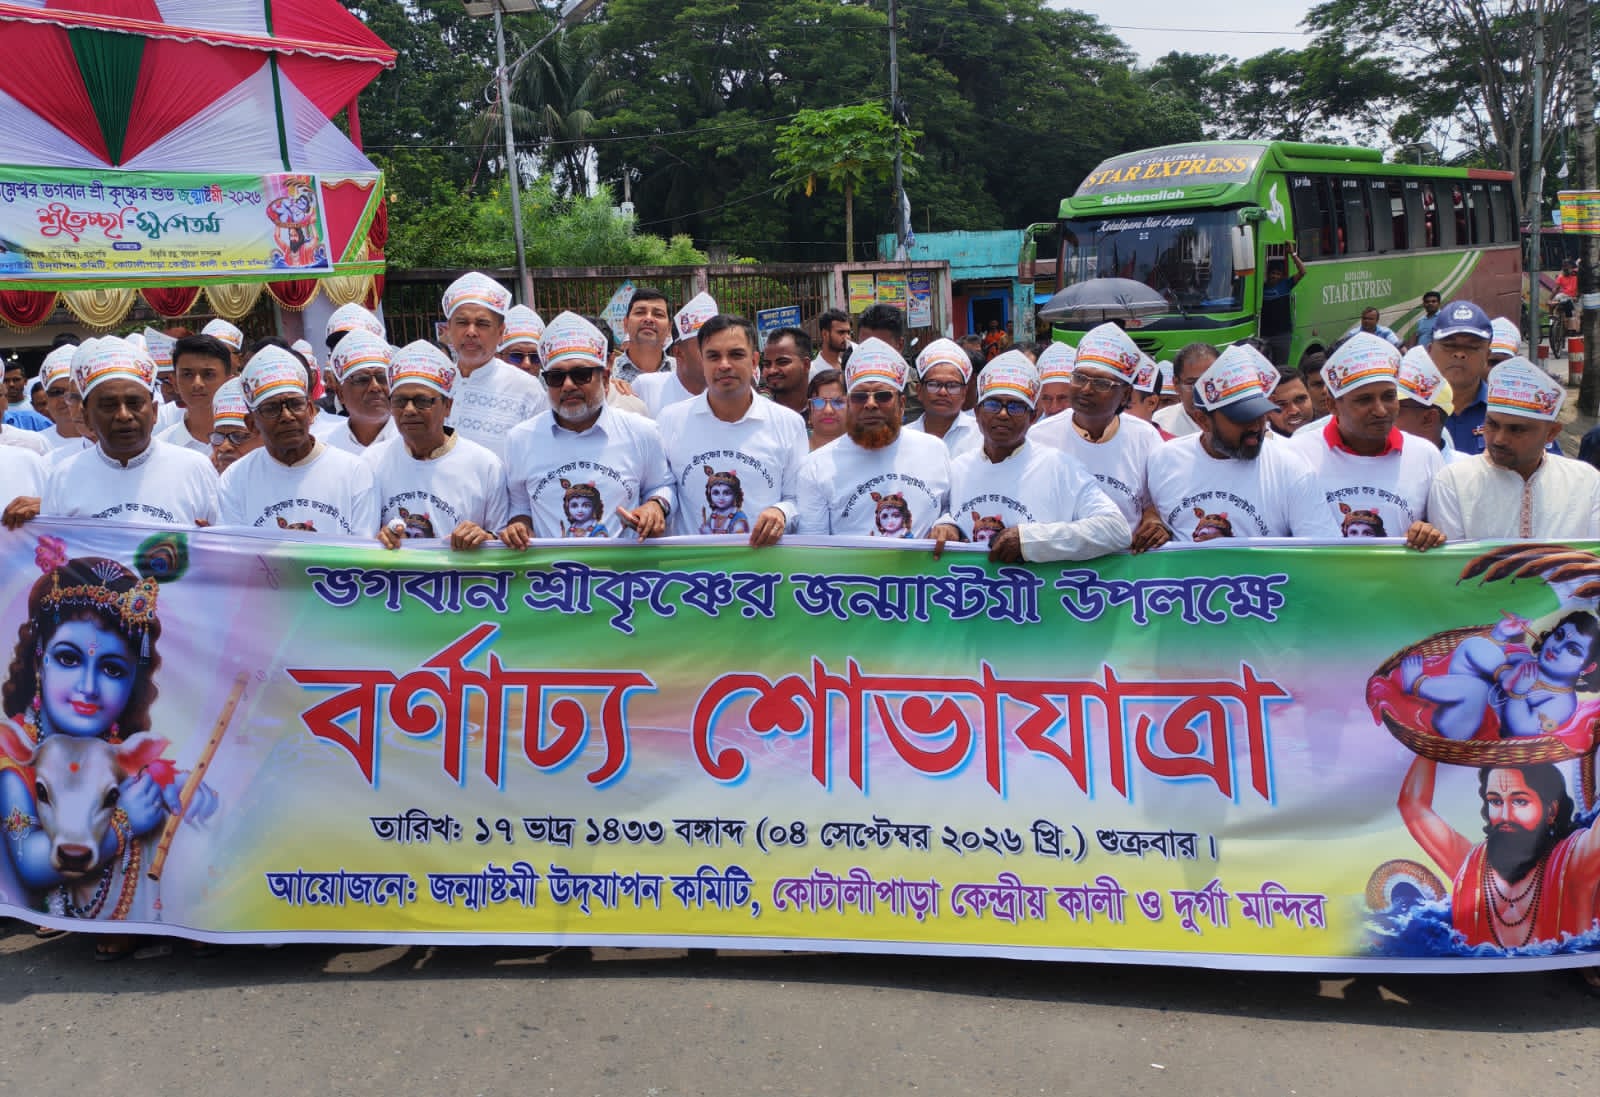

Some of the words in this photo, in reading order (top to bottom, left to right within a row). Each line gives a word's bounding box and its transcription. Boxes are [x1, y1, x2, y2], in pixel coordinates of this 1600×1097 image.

[1083, 165, 1142, 188] STAR
[1141, 157, 1251, 180] EXPRESS
[0, 182, 38, 203] মেশ্বর
[41, 182, 87, 201] ভগবান
[89, 180, 105, 201] শ্রী
[109, 186, 147, 208] কৃষ্ণের
[150, 187, 175, 202] শুভ
[1102, 189, 1185, 205] Subhanallah
[1322, 284, 1350, 305] STAR
[1351, 279, 1392, 302] EXPRESS
[307, 565, 515, 613] ভগবান
[523, 561, 783, 635] শ্রীকৃষ্ণের
[790, 564, 1044, 625] জন্মাষ্টমী
[1055, 568, 1288, 626] উপলক্ষে
[285, 621, 660, 792] বর্ণাঢ্য
[691, 655, 1293, 806] শোভাযাত্রা
[370, 808, 463, 844] তারিখ:
[475, 815, 514, 844] ১৭
[524, 815, 577, 848] ভাদ্র
[585, 817, 664, 845] ১৪৩৩
[672, 817, 747, 848] বঙ্গাব্দ
[756, 816, 809, 853] (০৪
[820, 814, 932, 851] সেপ্টেম্বর
[942, 824, 1023, 857] ২০২৬
[1031, 819, 1088, 862] খ্রি.)
[1096, 829, 1199, 860] শুক্রবার
[265, 868, 418, 907] আয়োজনে:
[427, 860, 542, 912] জন্মাষ্টমী
[670, 864, 762, 918] কমিটি,
[771, 866, 943, 923] কোটালীপাড়া
[951, 870, 1049, 924] কেন্দ্রীয়
[1054, 874, 1127, 923] কালী
[1136, 888, 1164, 921] ও
[1169, 879, 1232, 935] দুর্গা
[1236, 880, 1329, 929] মন্দির
